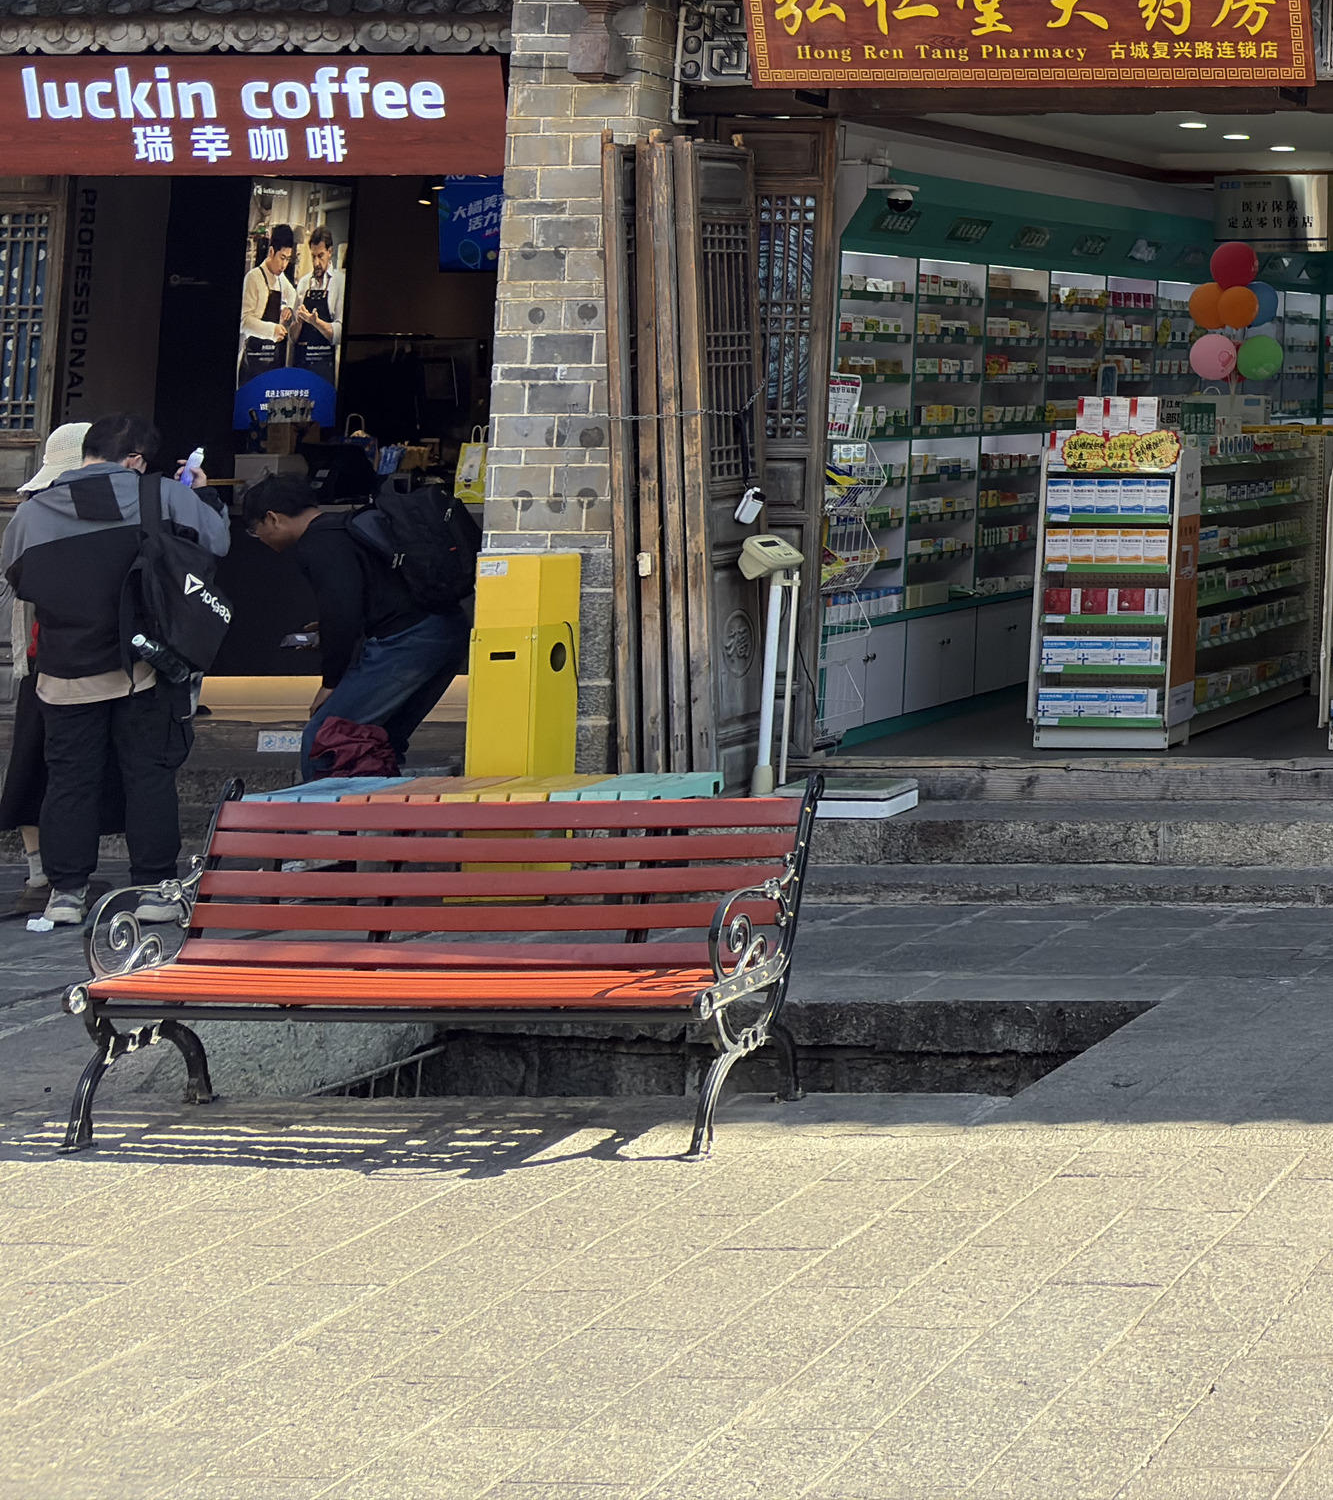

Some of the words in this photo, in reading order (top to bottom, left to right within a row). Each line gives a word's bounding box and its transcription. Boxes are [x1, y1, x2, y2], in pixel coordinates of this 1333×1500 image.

[796, 45, 853, 63] Hong
[863, 45, 905, 61] Ren
[914, 45, 970, 63] Tang
[980, 43, 1089, 63] Pharmacy
[1107, 41, 1280, 61] 古城复兴路连锁店
[21, 66, 218, 121] luckin
[241, 66, 447, 120] coffee
[133, 125, 348, 163] 瑞幸咖啡
[1241, 200, 1299, 213] 医疗保障
[1228, 215, 1314, 229] 定点零售药店
